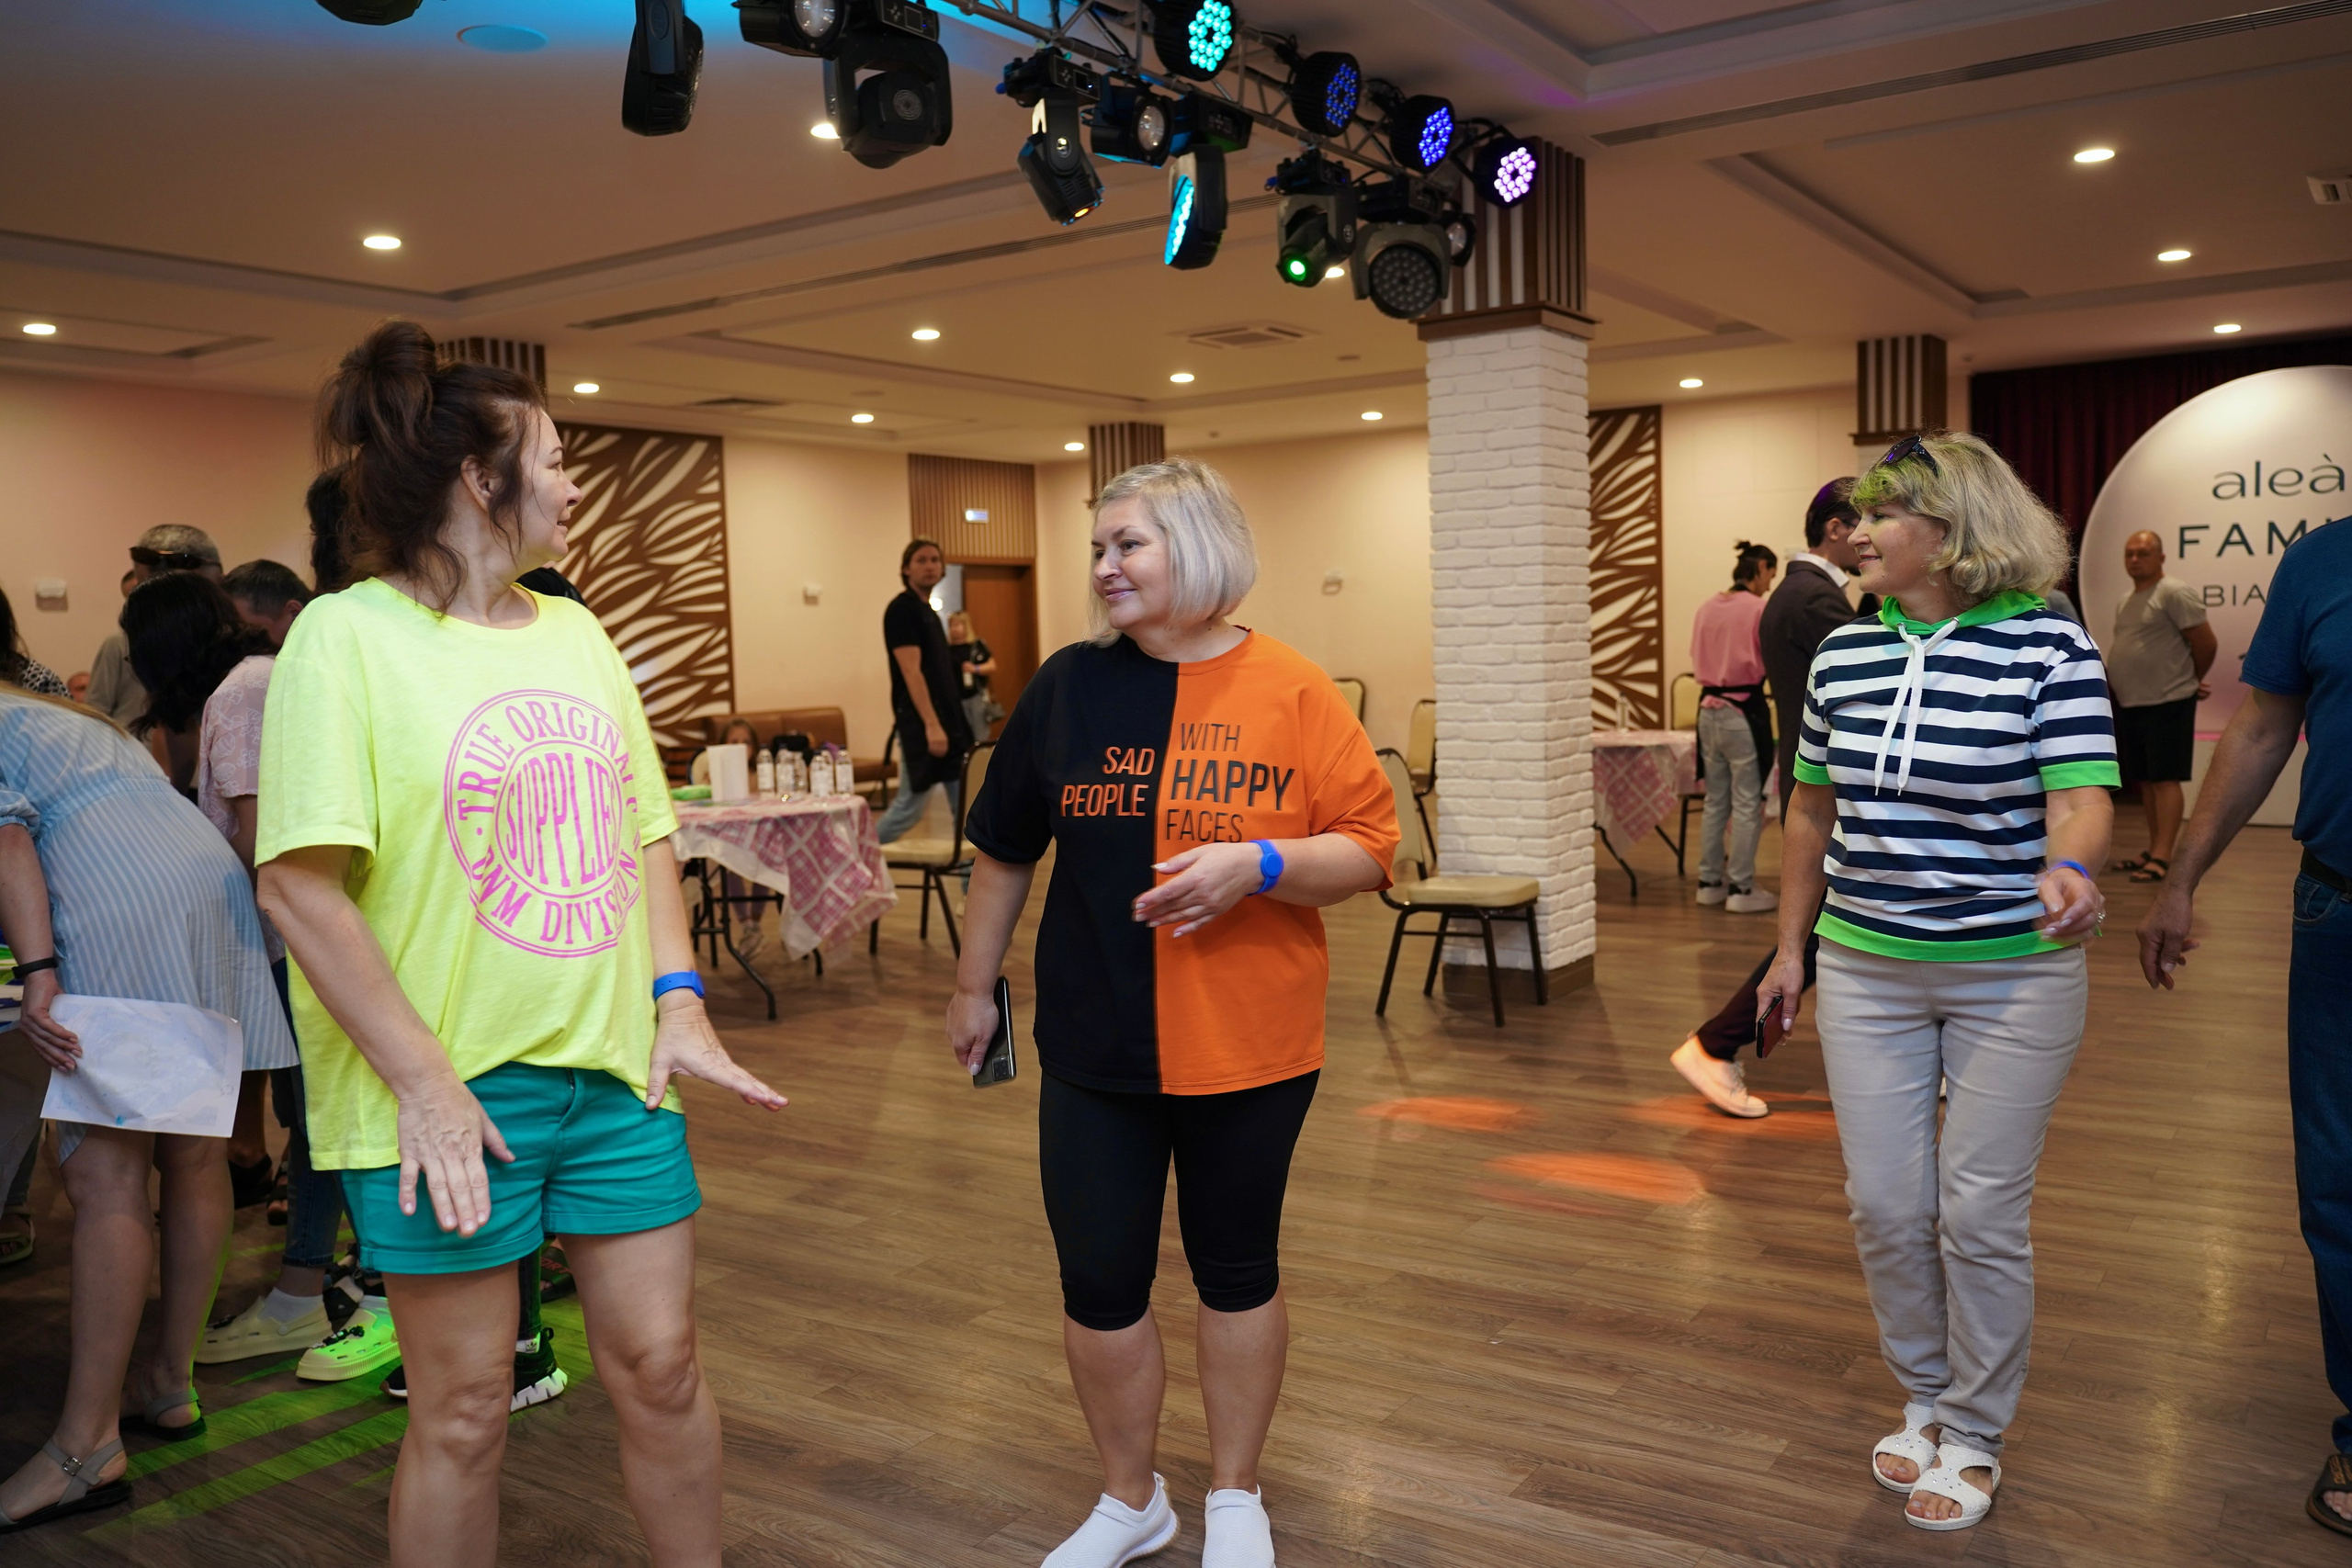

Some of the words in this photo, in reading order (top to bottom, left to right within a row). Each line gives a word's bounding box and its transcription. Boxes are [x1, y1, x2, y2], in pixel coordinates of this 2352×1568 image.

[2212, 454, 2346, 500] aleà
[2178, 518, 2332, 558] FAM
[1181, 722, 1240, 751] WITH
[457, 723, 515, 821] TRUE
[1102, 747, 1156, 775] SAD
[1060, 784, 1149, 817] PEOPLE
[1170, 759, 1295, 811] HAPPY
[1165, 808, 1244, 843] FACES
